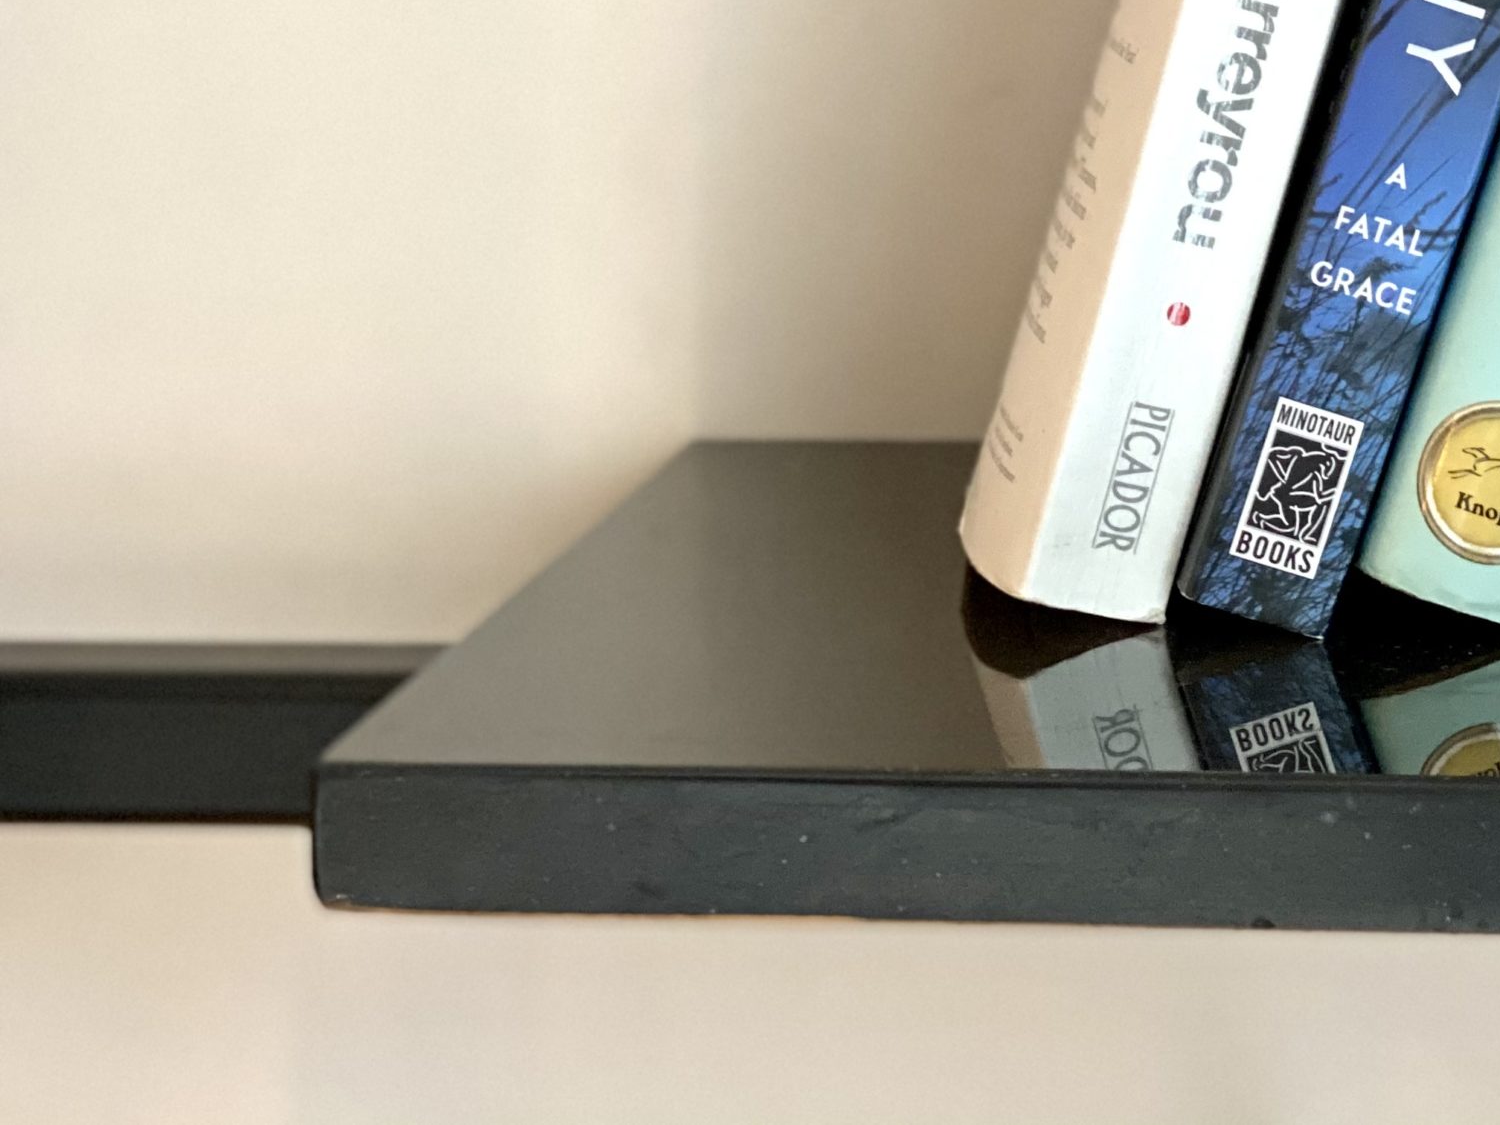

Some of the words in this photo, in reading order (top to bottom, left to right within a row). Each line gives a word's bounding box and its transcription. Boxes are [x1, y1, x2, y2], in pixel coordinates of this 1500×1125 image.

[1384, 162, 1408, 191] A
[1333, 205, 1424, 257] FATAL
[1310, 260, 1417, 315] GRACE
[1277, 403, 1356, 446] MINOTAUR
[1093, 401, 1172, 553] PICADOR
[1235, 529, 1315, 574] BOOKS
